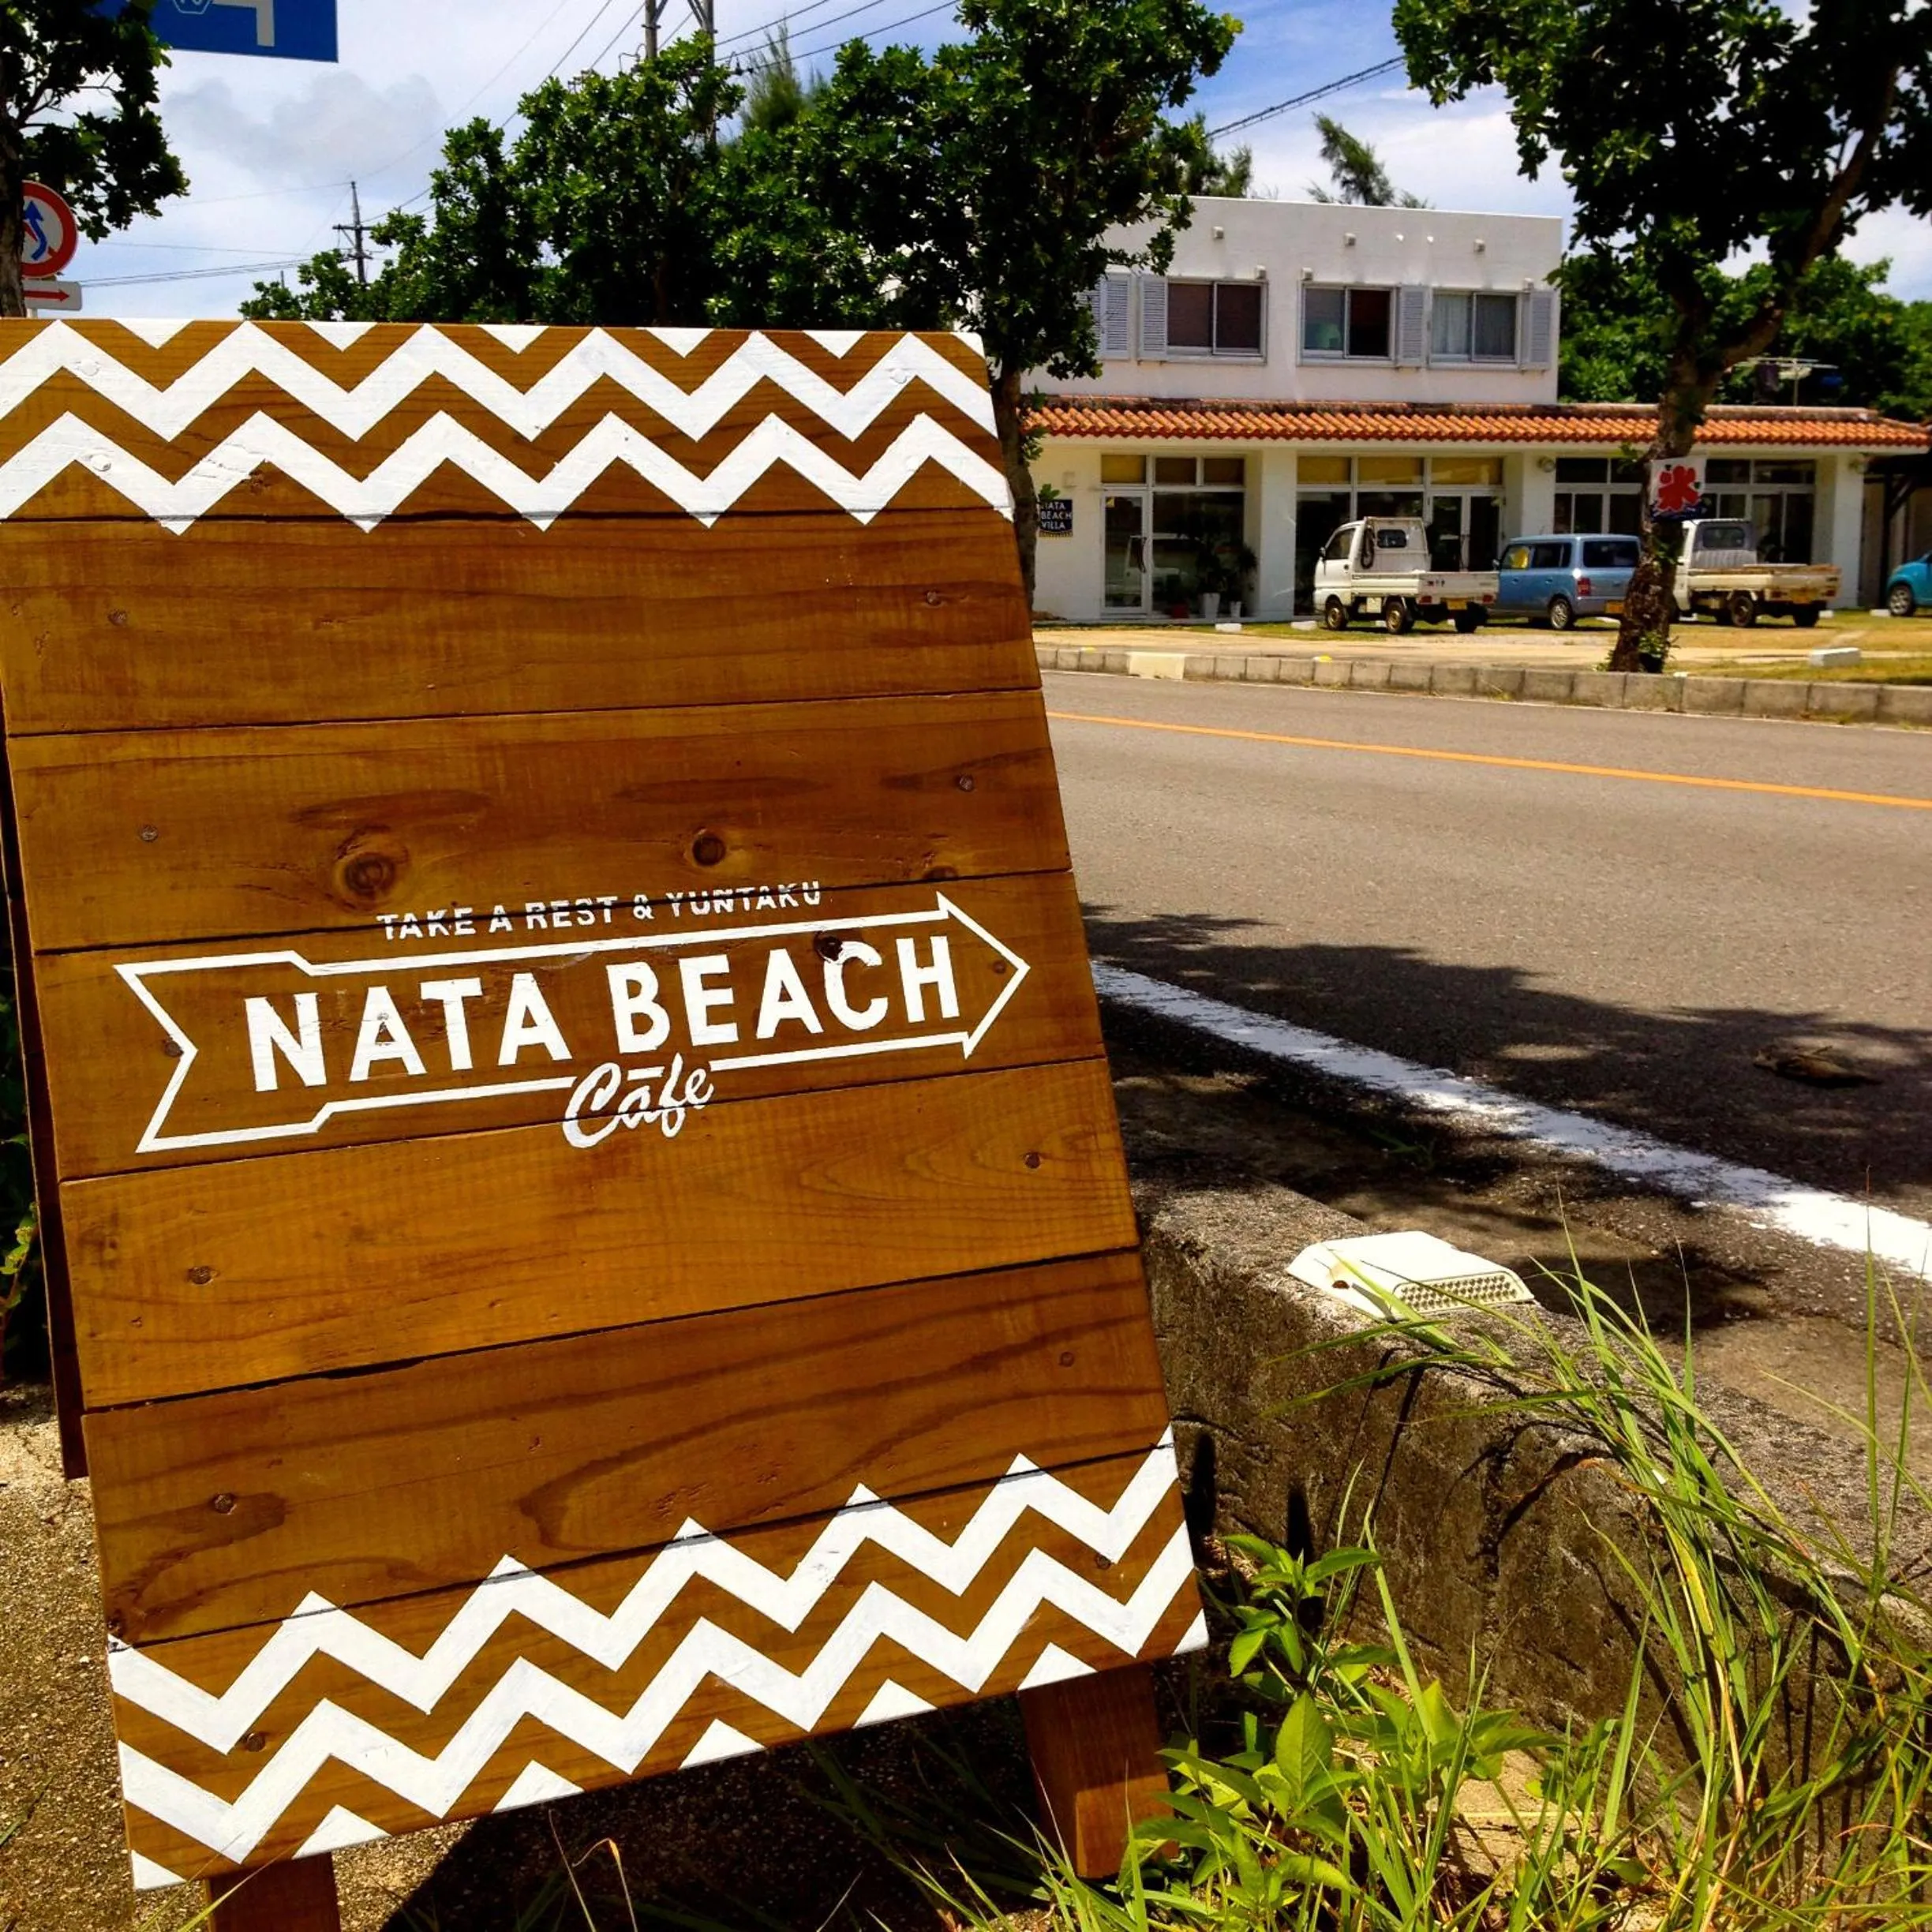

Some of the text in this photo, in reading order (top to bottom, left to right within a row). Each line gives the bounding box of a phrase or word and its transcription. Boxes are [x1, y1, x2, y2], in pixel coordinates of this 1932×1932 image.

[1041, 511, 1073, 519] BEACH
[1041, 521, 1065, 530] VILLA
[376, 880, 821, 941] TAKE A REST & YUNTAKU
[244, 936, 960, 1092] NATA BEACH
[562, 1052, 714, 1148] Cafe
